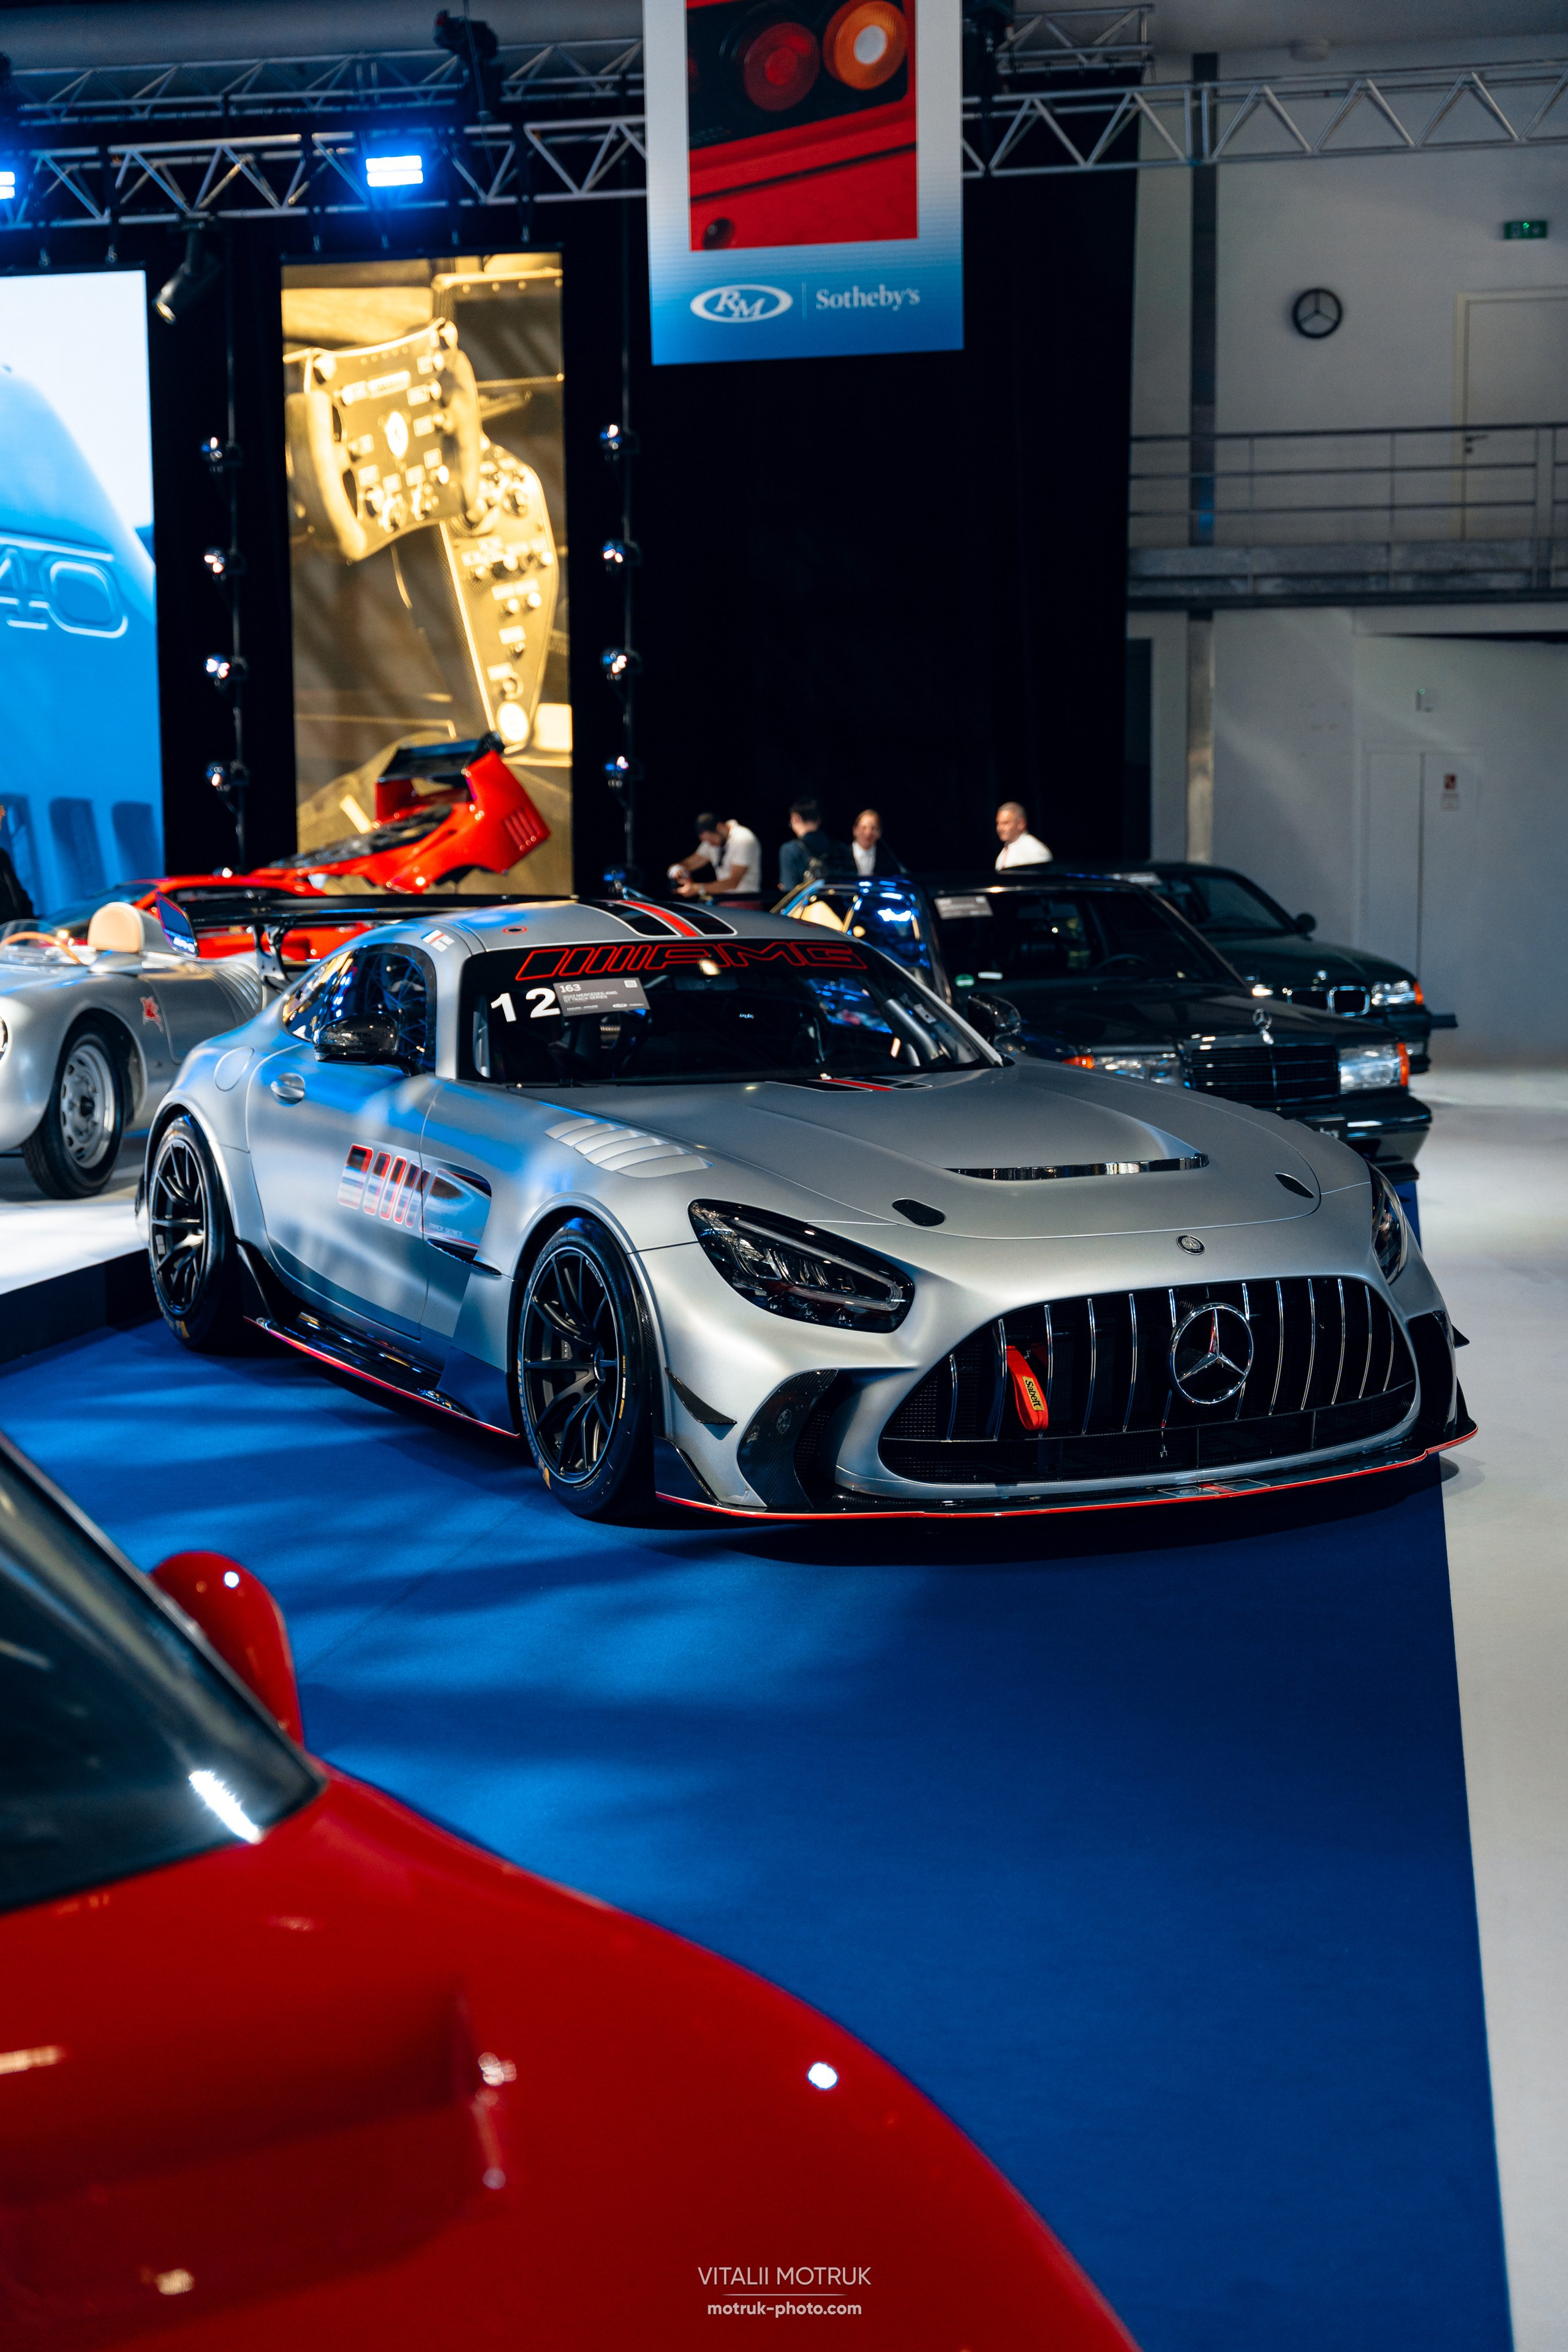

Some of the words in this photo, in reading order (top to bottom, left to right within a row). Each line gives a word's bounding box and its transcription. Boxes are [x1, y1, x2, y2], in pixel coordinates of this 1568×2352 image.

[816, 284, 920, 311] Sotheby's
[644, 941, 867, 970] AMG
[559, 984, 581, 993] 163
[429, 1223, 444, 1232] TRACK
[445, 1227, 463, 1237] SERIES
[1025, 1379, 1041, 1408] Sabelt
